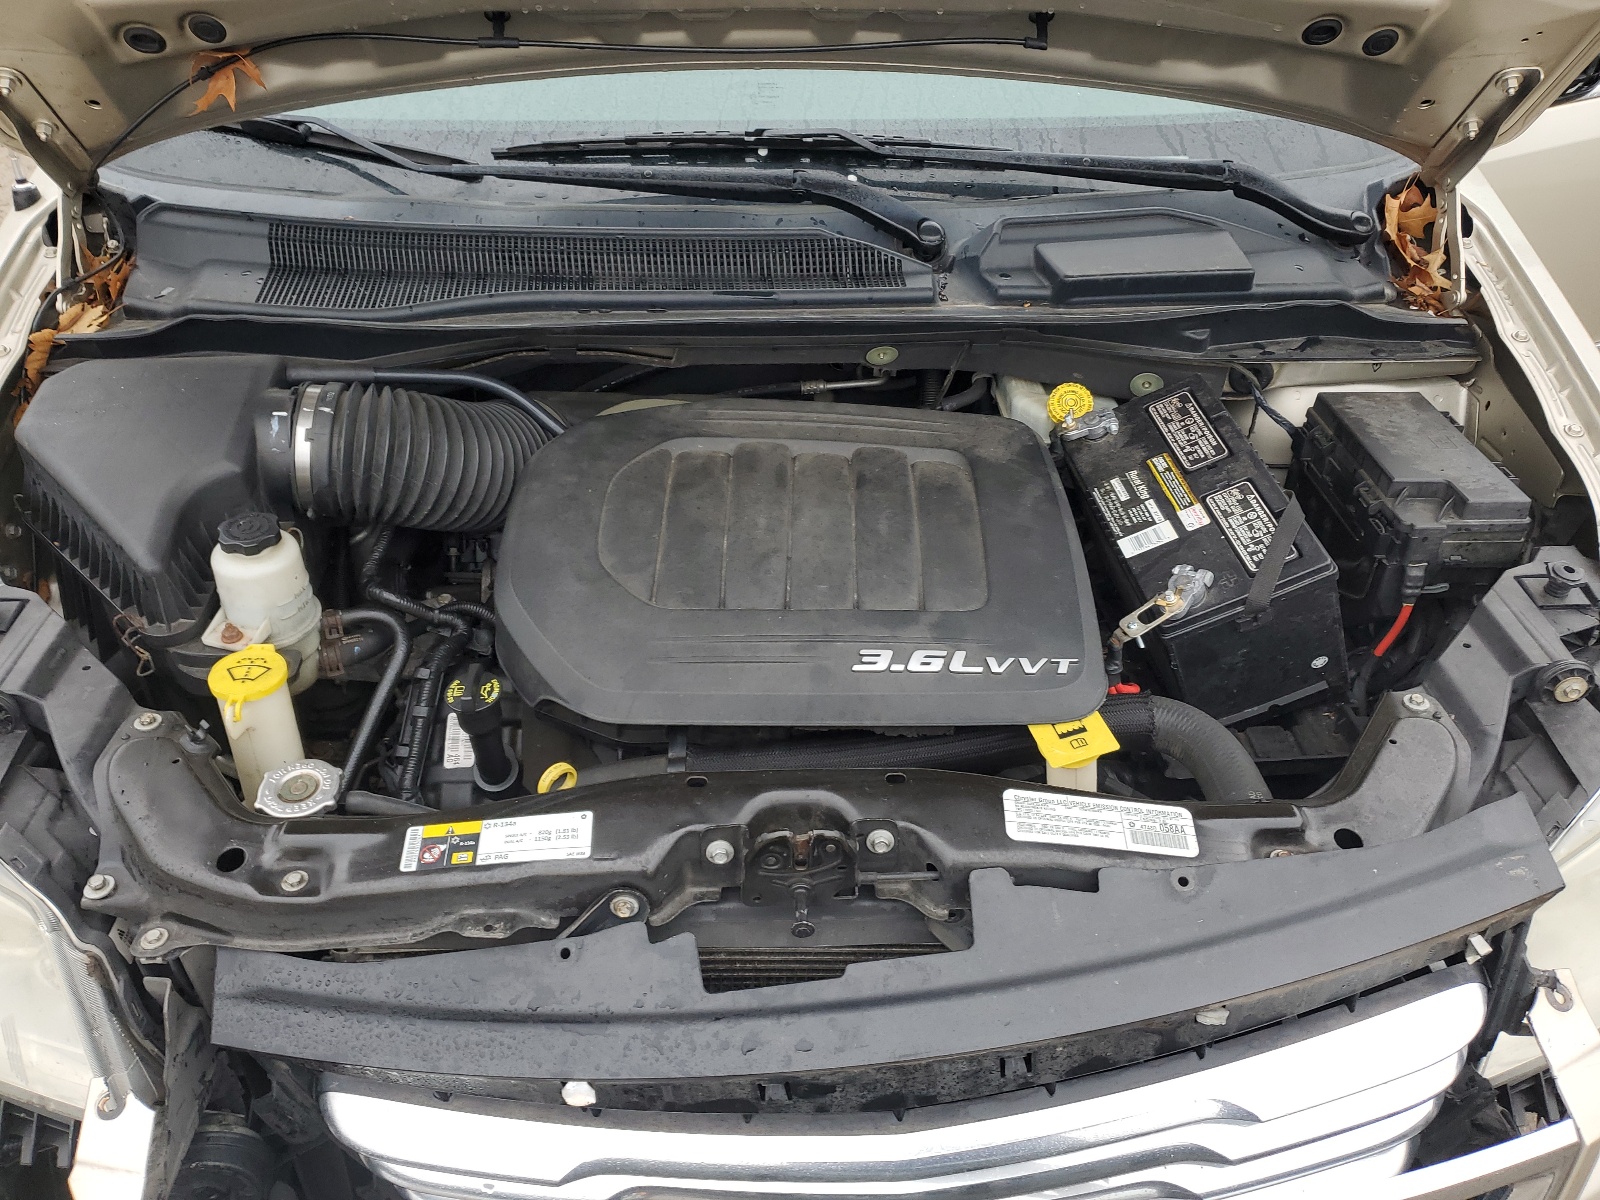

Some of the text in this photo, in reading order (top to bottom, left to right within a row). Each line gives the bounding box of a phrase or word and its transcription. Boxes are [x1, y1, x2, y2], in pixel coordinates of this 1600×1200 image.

[851, 649, 1079, 674] 3.6L VVT
[1013, 794, 1037, 803] Chrysler
[1039, 797, 1055, 805] Group
[1069, 799, 1091, 808] VEHICLE
[1093, 802, 1118, 810] EMISSION
[1120, 805, 1144, 814] CONTROL
[1146, 808, 1182, 818] INFORMATION
